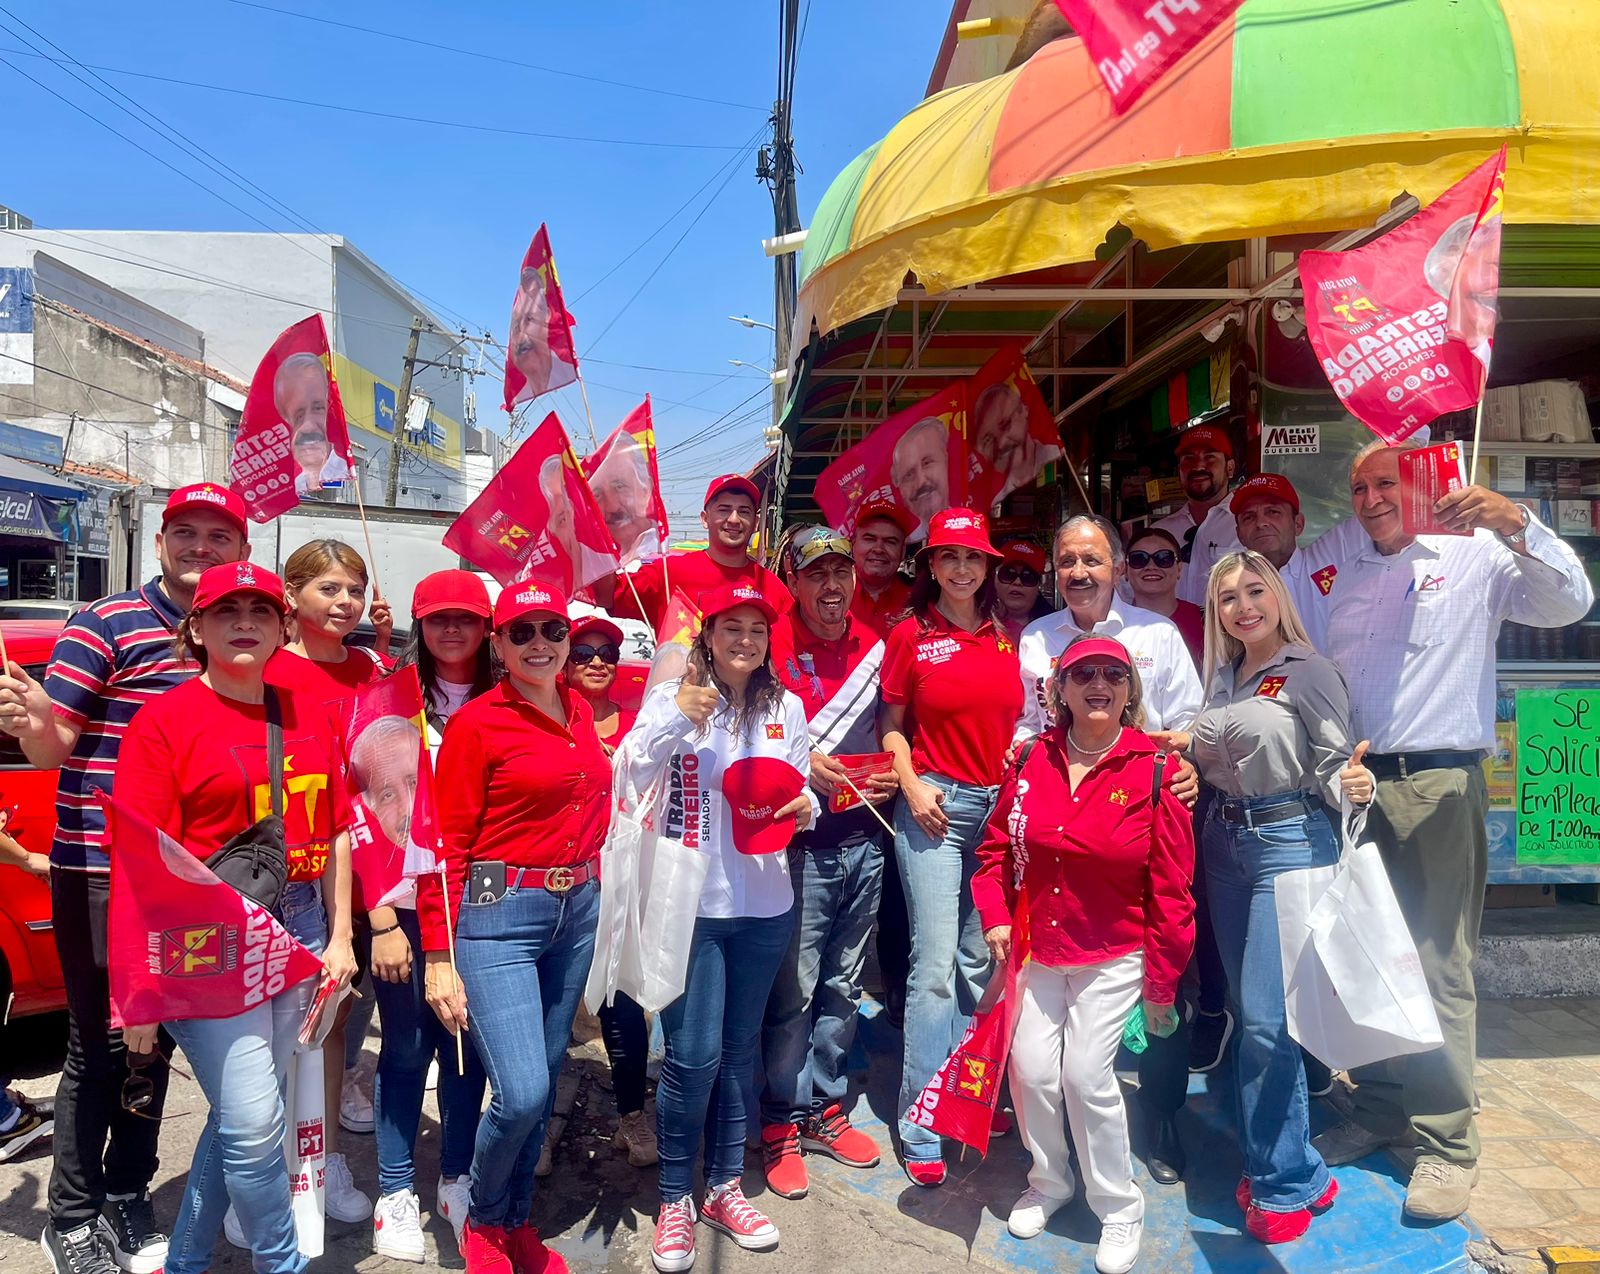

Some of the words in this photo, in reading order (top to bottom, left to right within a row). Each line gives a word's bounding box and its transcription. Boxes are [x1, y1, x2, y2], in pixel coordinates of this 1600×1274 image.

[1265, 428, 1316, 448] MENY
[917, 653, 928, 662] DE
[928, 650, 940, 658] LA
[939, 644, 961, 655] CRUZ
[918, 638, 956, 653] YOLANDA
[1256, 683, 1282, 695] PT
[1553, 693, 1592, 730] Se
[666, 753, 684, 839] TRADA
[682, 754, 699, 849] RREIRO
[837, 794, 852, 806] PT
[702, 790, 711, 842] SENADOR
[1520, 820, 1540, 837] De
[290, 849, 306, 858] DEL
[960, 1058, 987, 1098] PT
[300, 1135, 321, 1154] PT
